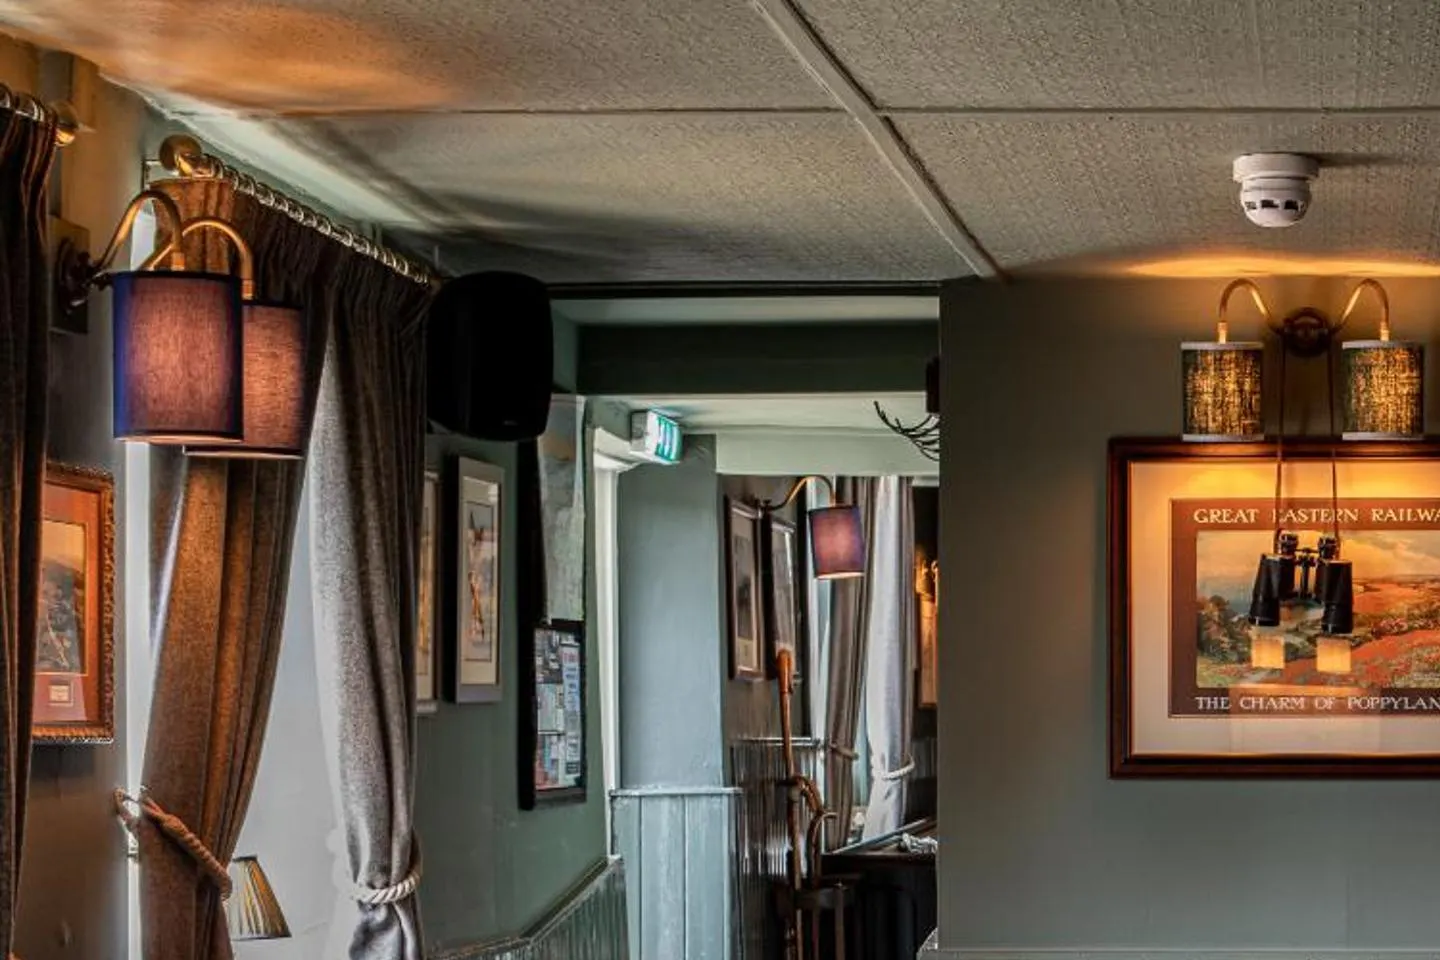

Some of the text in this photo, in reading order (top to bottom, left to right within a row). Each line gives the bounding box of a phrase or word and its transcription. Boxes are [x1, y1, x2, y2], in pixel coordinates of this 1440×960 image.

[1193, 508, 1259, 524] GREAT
[1195, 696, 1231, 710] THE
[1239, 696, 1305, 710] CHARM
[1314, 696, 1336, 710] OF
